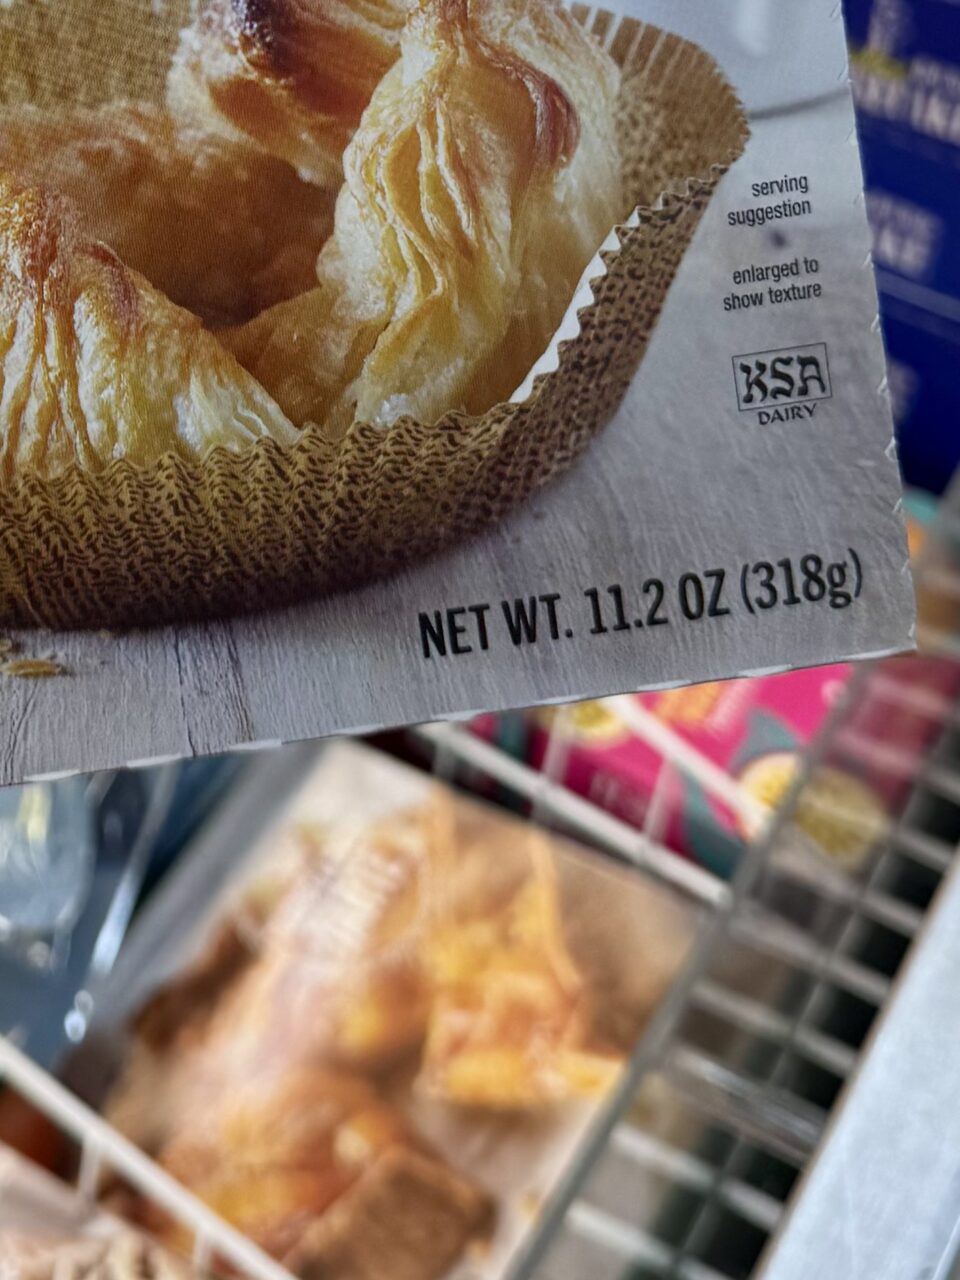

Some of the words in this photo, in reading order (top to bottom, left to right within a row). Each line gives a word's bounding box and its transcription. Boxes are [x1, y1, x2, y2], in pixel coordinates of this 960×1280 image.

[751, 175, 809, 197] serving
[727, 199, 812, 227] suggestion
[733, 258, 799, 285] enlarged
[803, 256, 819, 274] to
[723, 292, 764, 312] show
[768, 282, 822, 305] texture
[740, 354, 826, 404] KSA
[756, 402, 817, 426] DAIRY
[418, 604, 490, 658] NET
[501, 593, 573, 645] WT.
[584, 579, 669, 634] 11.2
[678, 569, 730, 620] OZ
[741, 547, 863, 615] (318g)
